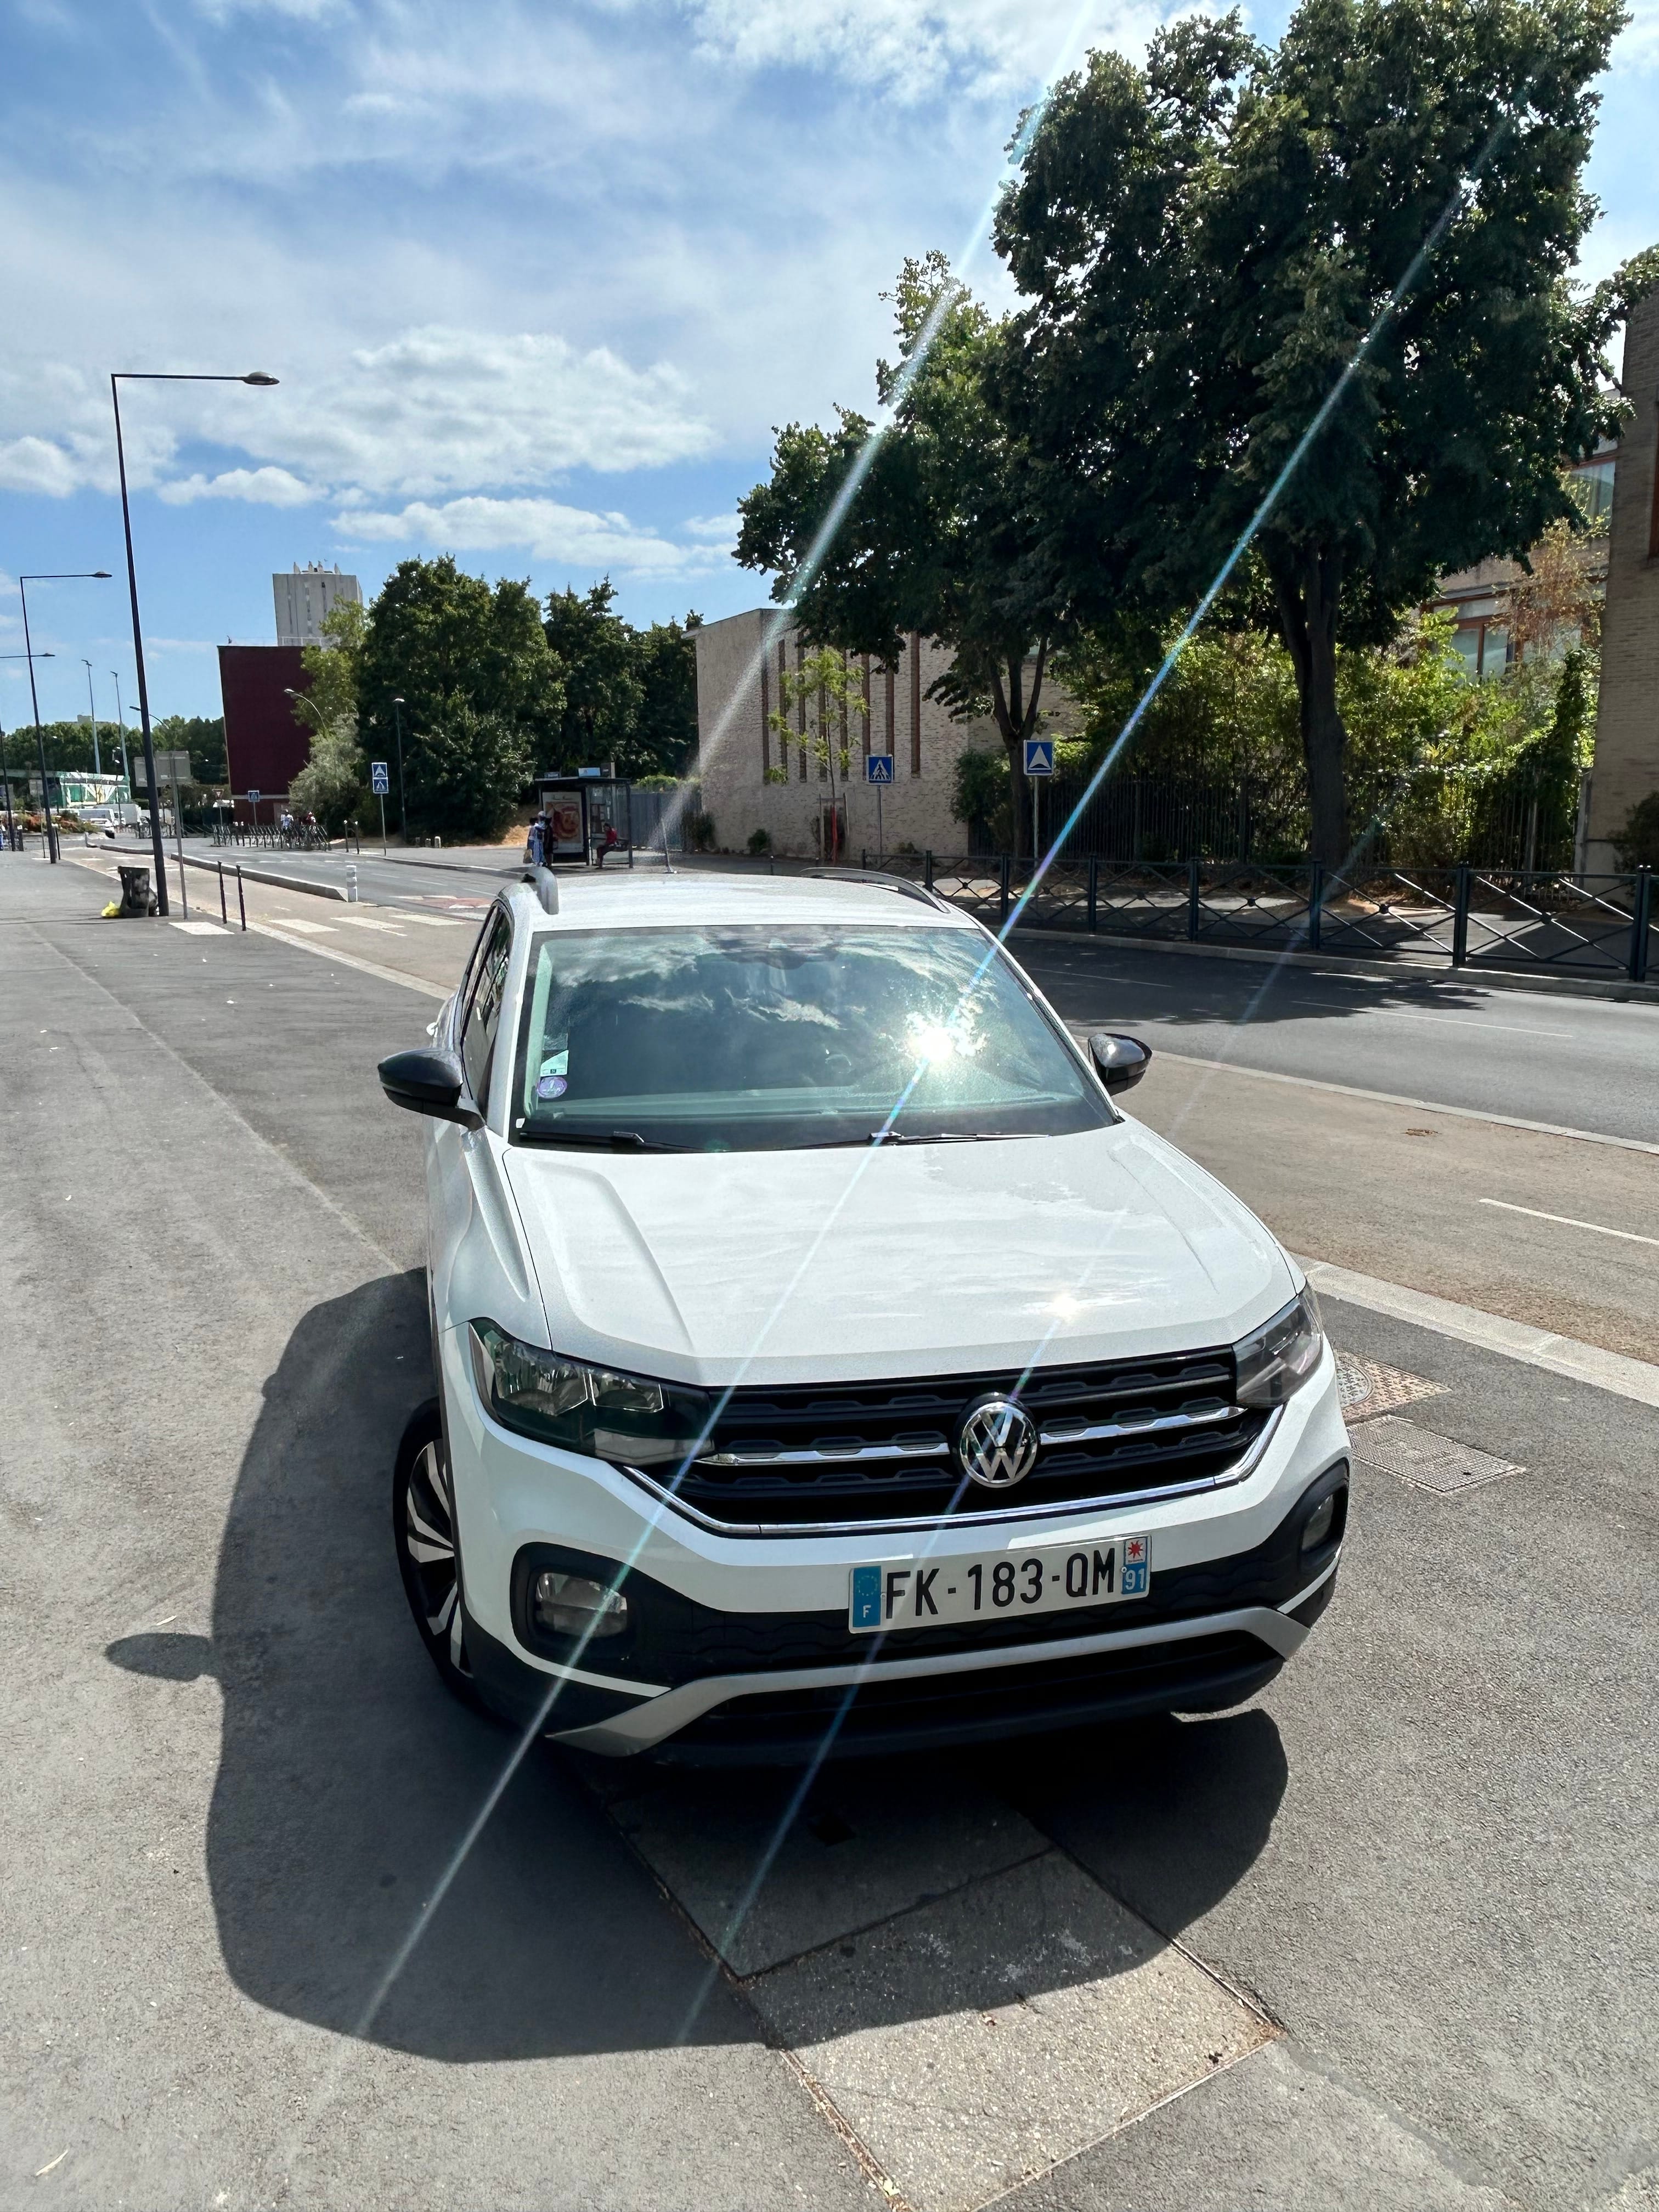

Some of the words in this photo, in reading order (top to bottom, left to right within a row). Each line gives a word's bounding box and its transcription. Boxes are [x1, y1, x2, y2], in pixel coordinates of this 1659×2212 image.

[967, 1404, 1028, 1483] VW
[886, 1548, 1115, 1618] FK-183-QM
[1125, 1568, 1145, 1590] 91
[862, 1605, 872, 1618] F
